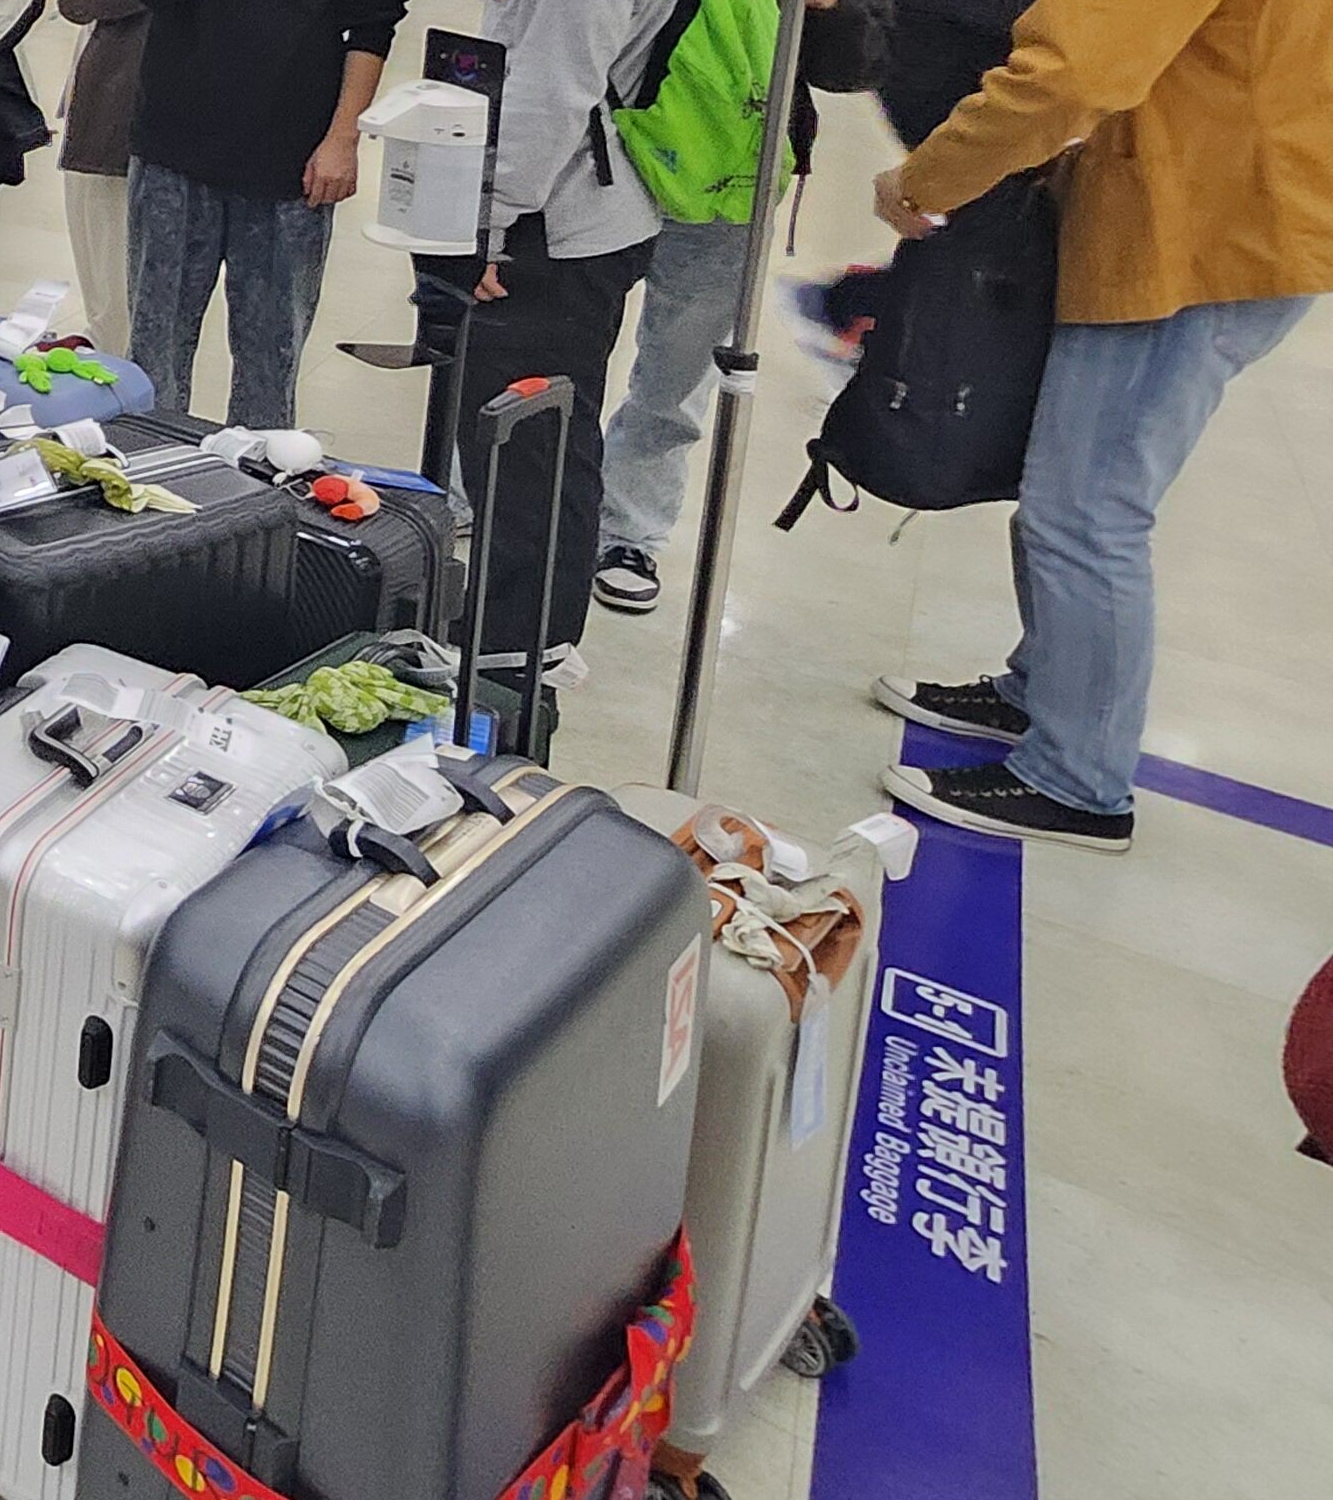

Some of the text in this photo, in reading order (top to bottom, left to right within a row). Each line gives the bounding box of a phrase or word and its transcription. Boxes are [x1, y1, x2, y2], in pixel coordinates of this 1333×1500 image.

[914, 984, 975, 1042] 5-1
[859, 1034, 919, 1226] Unclaimed Baggage
[911, 1045, 1008, 1284] 未提領行李
